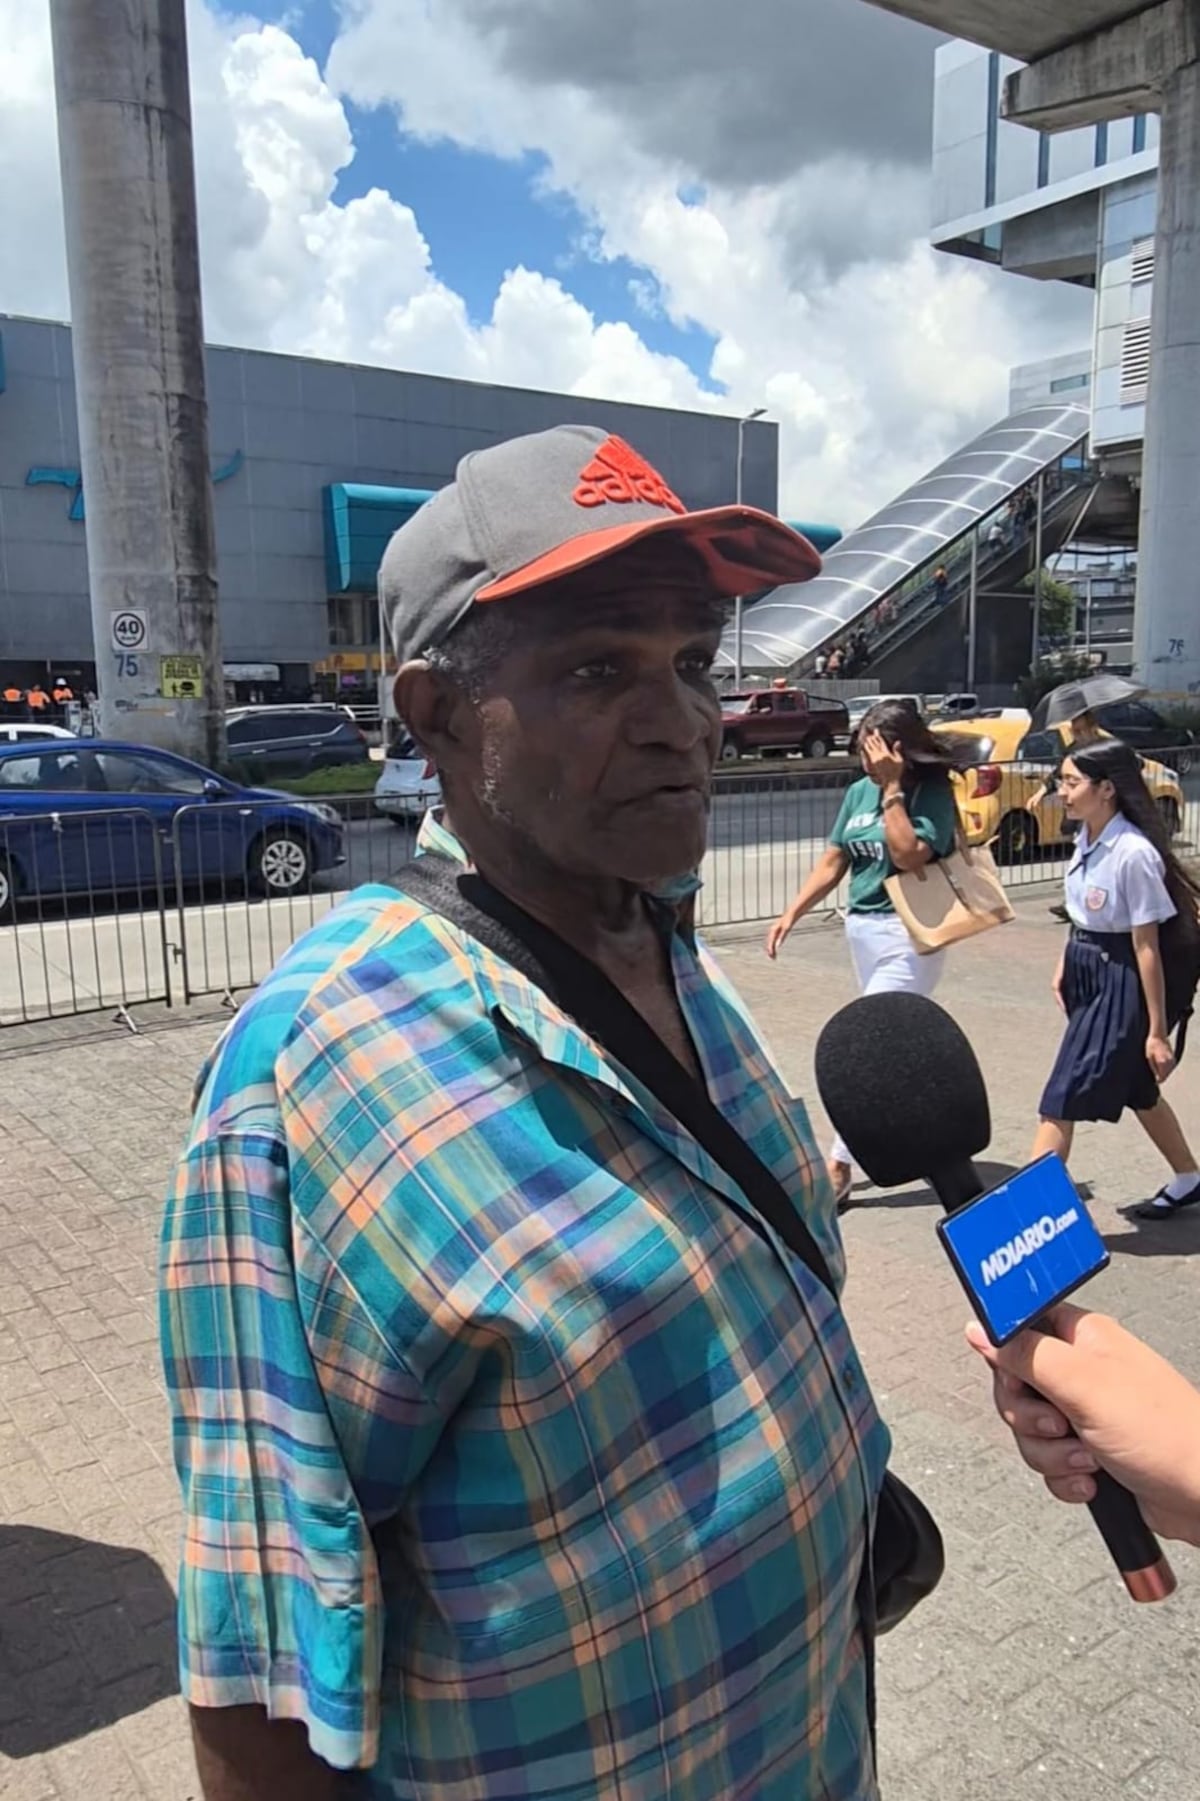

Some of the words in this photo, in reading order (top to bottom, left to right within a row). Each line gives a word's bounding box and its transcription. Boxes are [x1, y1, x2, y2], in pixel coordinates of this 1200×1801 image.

[572, 471, 688, 515] adida
[117, 620, 139, 634] 40
[114, 653, 138, 677] 75
[980, 1208, 1079, 1287] MDIARIO.com
